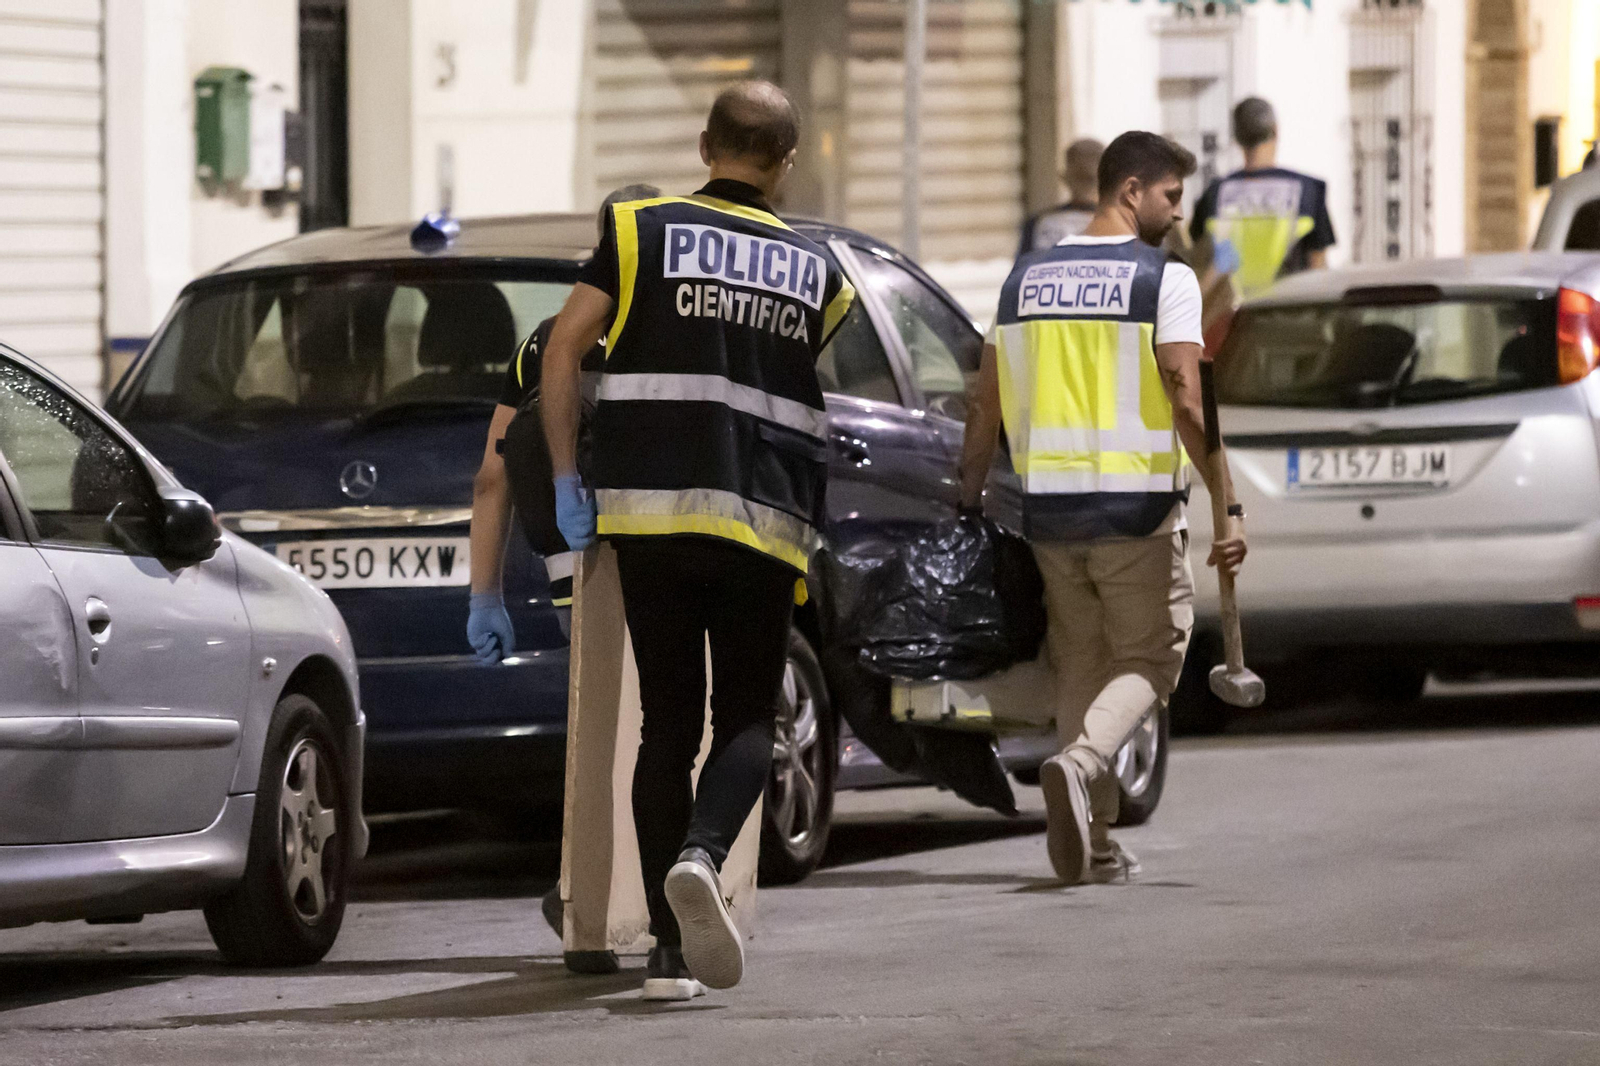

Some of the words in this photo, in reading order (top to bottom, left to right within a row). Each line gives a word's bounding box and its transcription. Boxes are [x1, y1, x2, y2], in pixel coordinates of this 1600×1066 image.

[669, 227, 820, 305] POLICIA
[1026, 266, 1064, 280] CUERPO
[1065, 265, 1113, 279] NACIONAL
[1116, 266, 1131, 279] DE
[1021, 283, 1124, 310] POLICIA
[675, 282, 809, 344] CIENTIFICA
[1310, 450, 1381, 480] 2157
[389, 545, 457, 579] KXW
